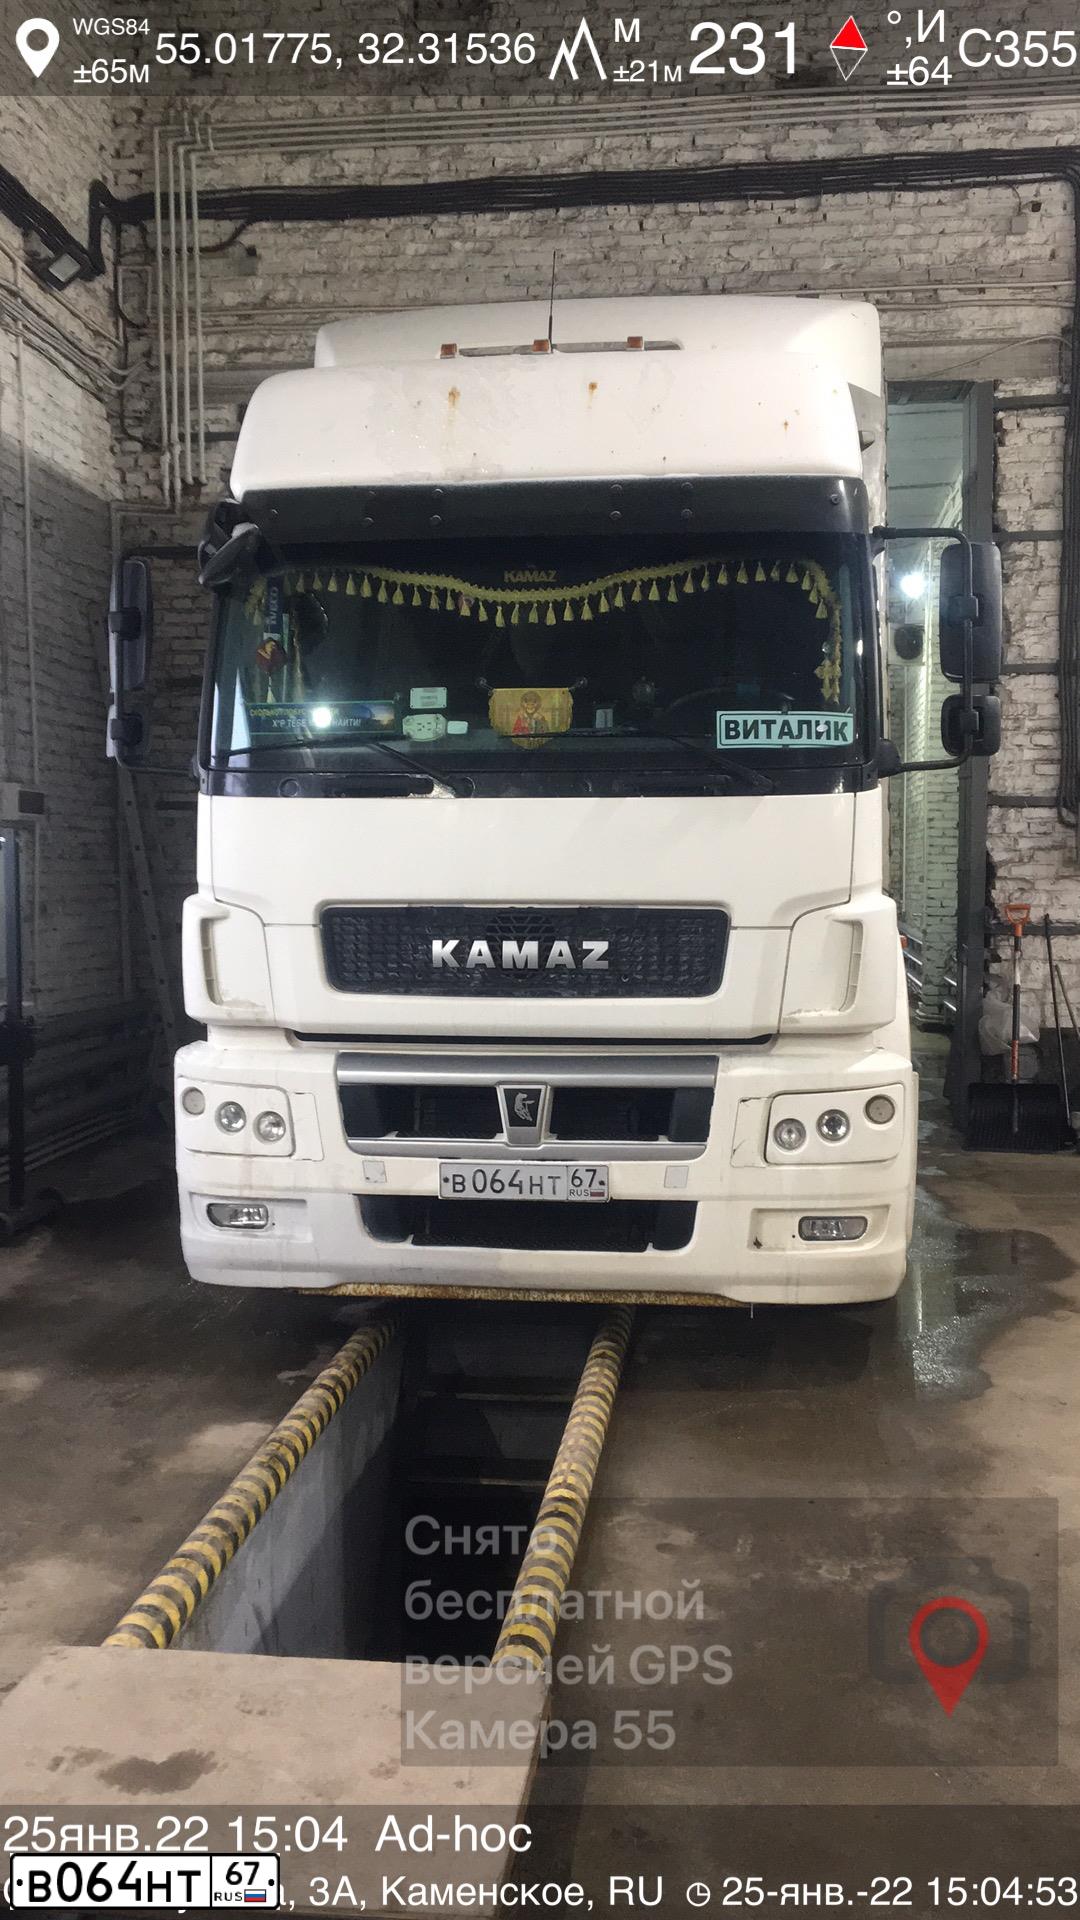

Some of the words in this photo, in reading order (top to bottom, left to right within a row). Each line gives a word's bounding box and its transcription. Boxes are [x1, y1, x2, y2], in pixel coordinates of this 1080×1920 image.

[504, 569, 557, 583] KAMAZ
[723, 719, 849, 741] ВИТАЛИК
[432, 939, 609, 970] KAMAZ
[571, 1168, 597, 1188] 67
[569, 1189, 590, 1197] RUS
